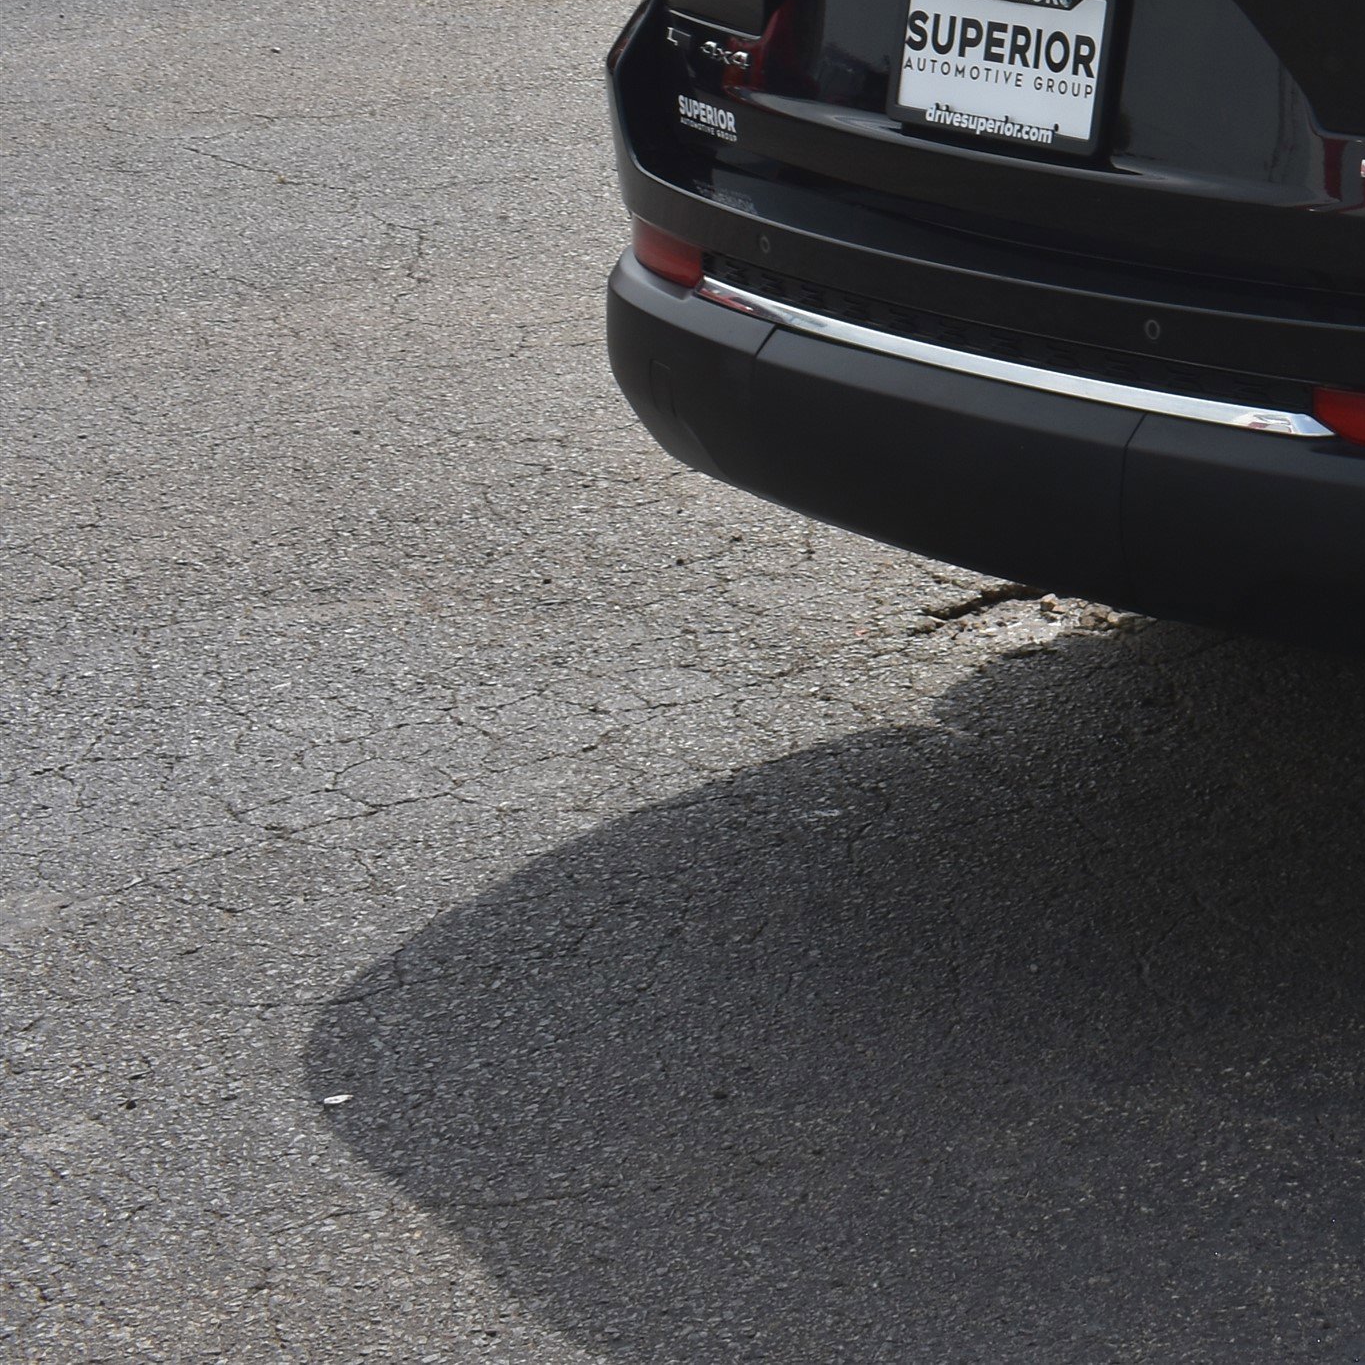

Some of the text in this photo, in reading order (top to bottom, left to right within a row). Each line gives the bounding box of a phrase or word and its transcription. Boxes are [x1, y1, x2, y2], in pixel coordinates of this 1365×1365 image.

[905, 10, 1097, 79] SUPERIOR
[903, 56, 1094, 99] AUTOMOTIVE GROUP
[678, 94, 737, 134] SUPERIOR
[925, 102, 1055, 145] drivesuperior.com
